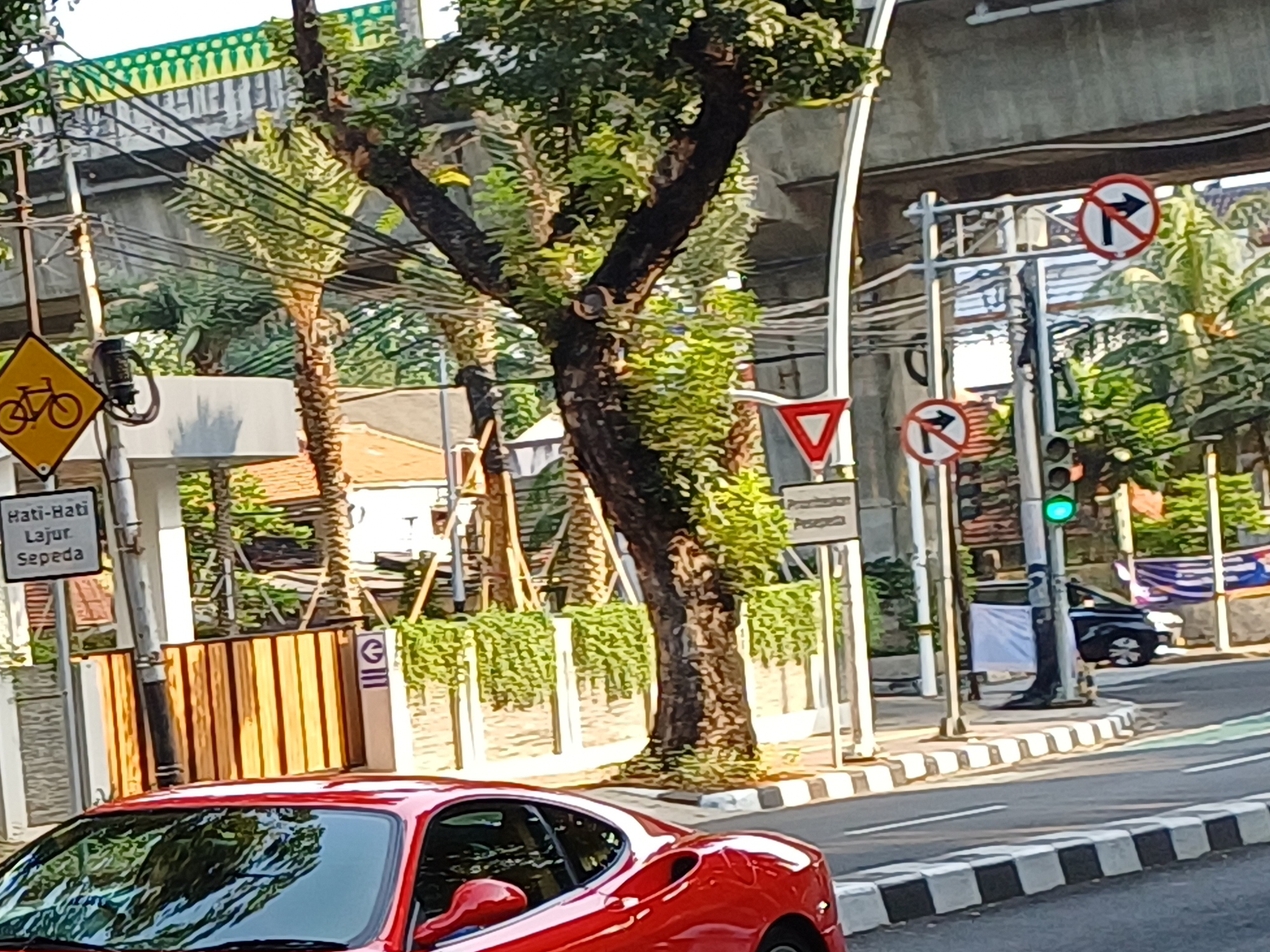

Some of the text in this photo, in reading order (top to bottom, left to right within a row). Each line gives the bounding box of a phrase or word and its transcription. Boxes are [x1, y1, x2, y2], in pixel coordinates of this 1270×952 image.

[7, 501, 89, 523] Hati-Hati
[25, 527, 72, 546] Lajur
[17, 547, 84, 566] Sepeda
